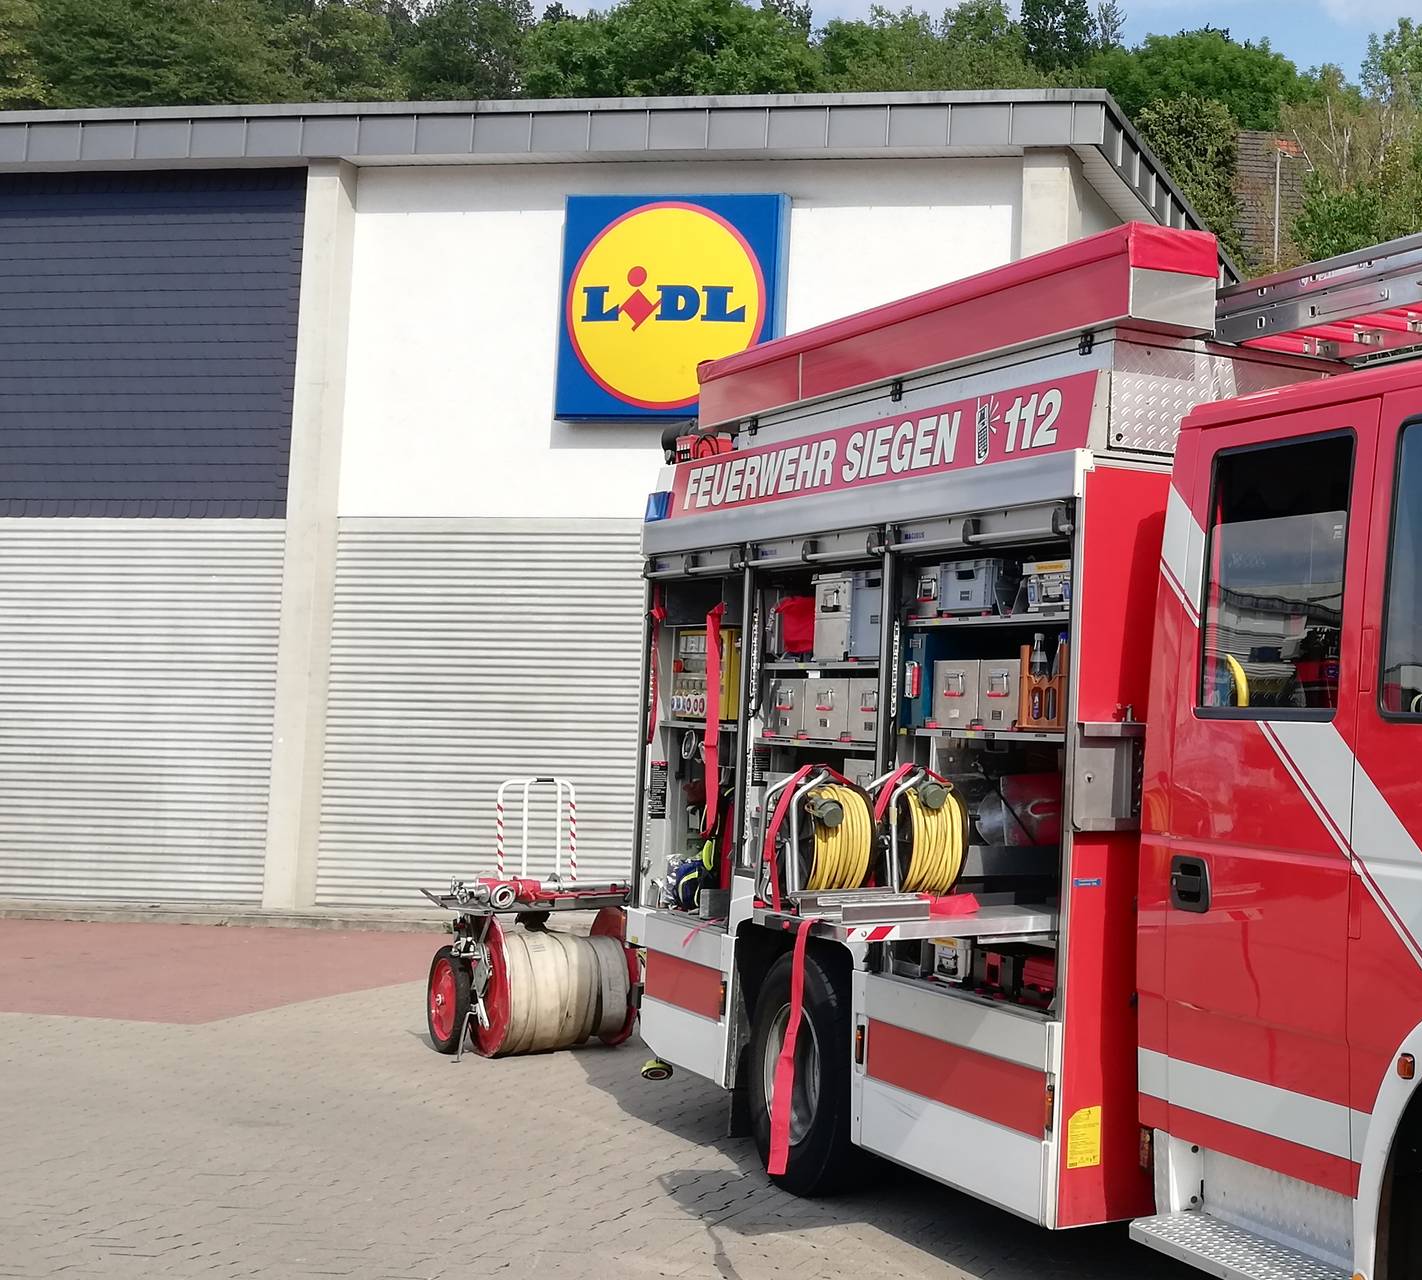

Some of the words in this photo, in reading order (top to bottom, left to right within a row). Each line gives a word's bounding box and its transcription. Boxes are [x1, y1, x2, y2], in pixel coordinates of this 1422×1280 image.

[682, 437, 838, 511] FEUERWEHR
[841, 410, 962, 483] SIEGEN
[1003, 388, 1064, 455] 112
